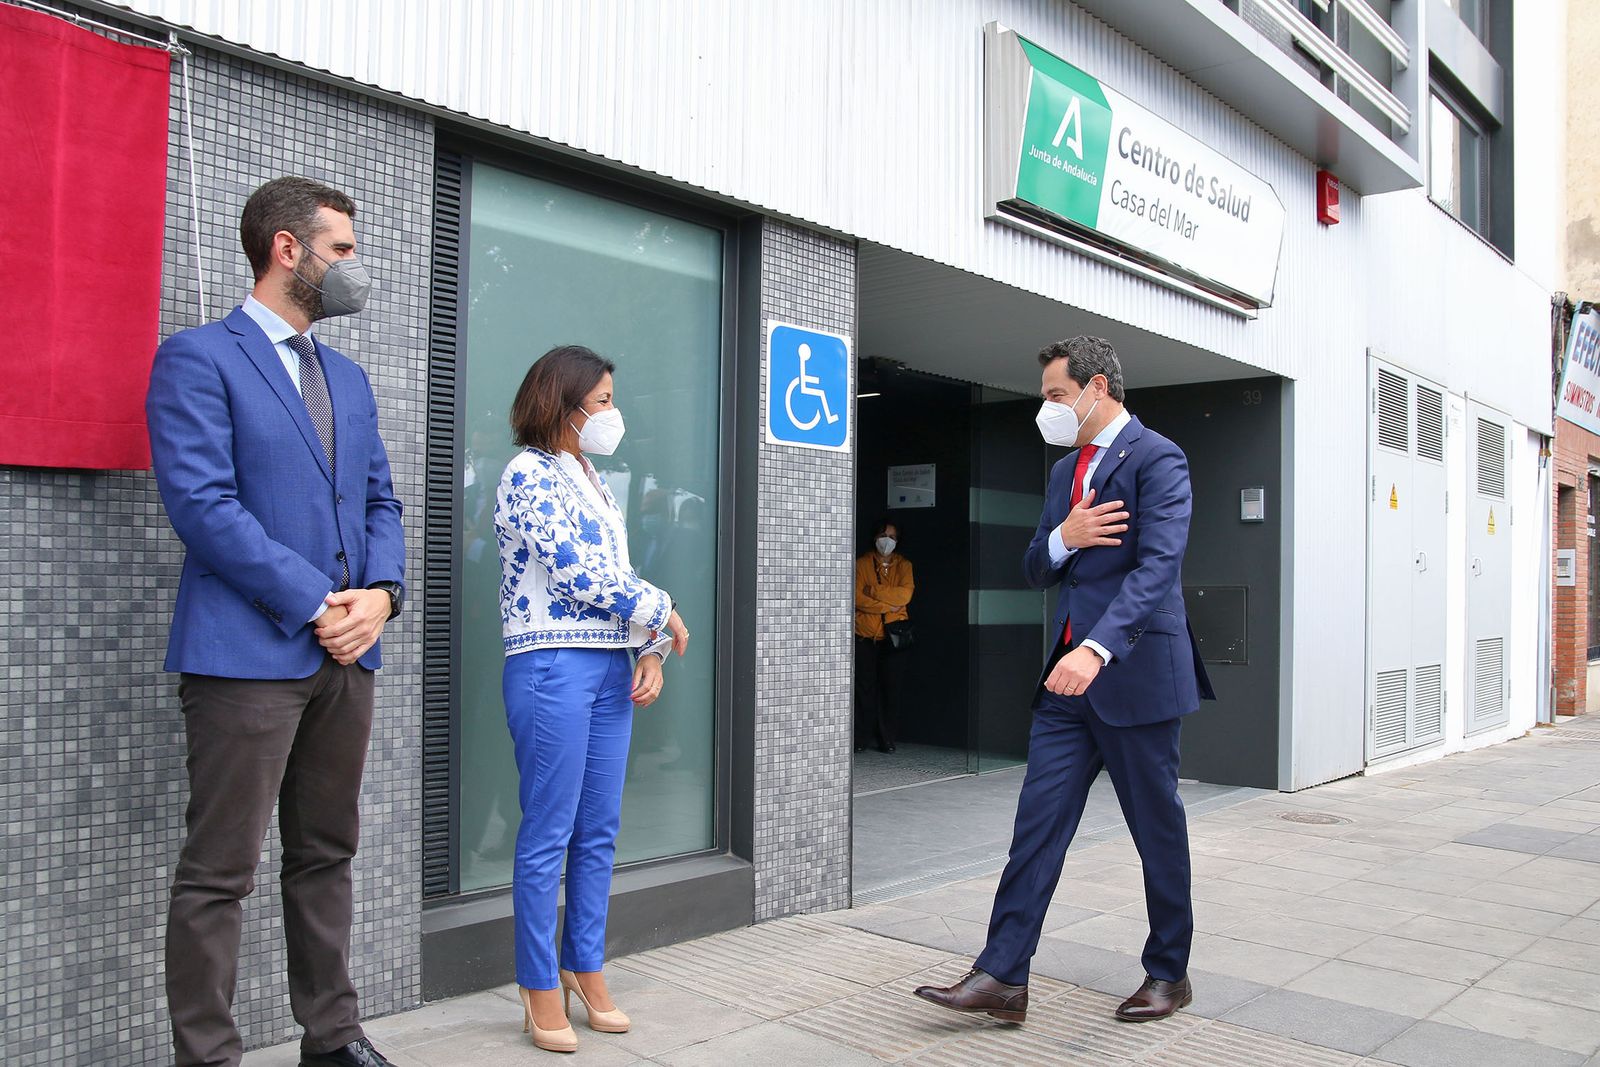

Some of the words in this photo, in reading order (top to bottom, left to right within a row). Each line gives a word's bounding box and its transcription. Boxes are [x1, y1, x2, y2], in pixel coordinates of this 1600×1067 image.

[1028, 144, 1051, 164] Junta
[1052, 155, 1062, 169] de
[1062, 160, 1097, 186] Andalucía
[1118, 126, 1180, 185] Centro
[1184, 163, 1204, 198] de
[1207, 176, 1251, 223] Salud
[1111, 179, 1146, 217] Casa
[1149, 197, 1172, 229] del
[1173, 209, 1199, 241] Mar
[1242, 390, 1262, 406] 39
